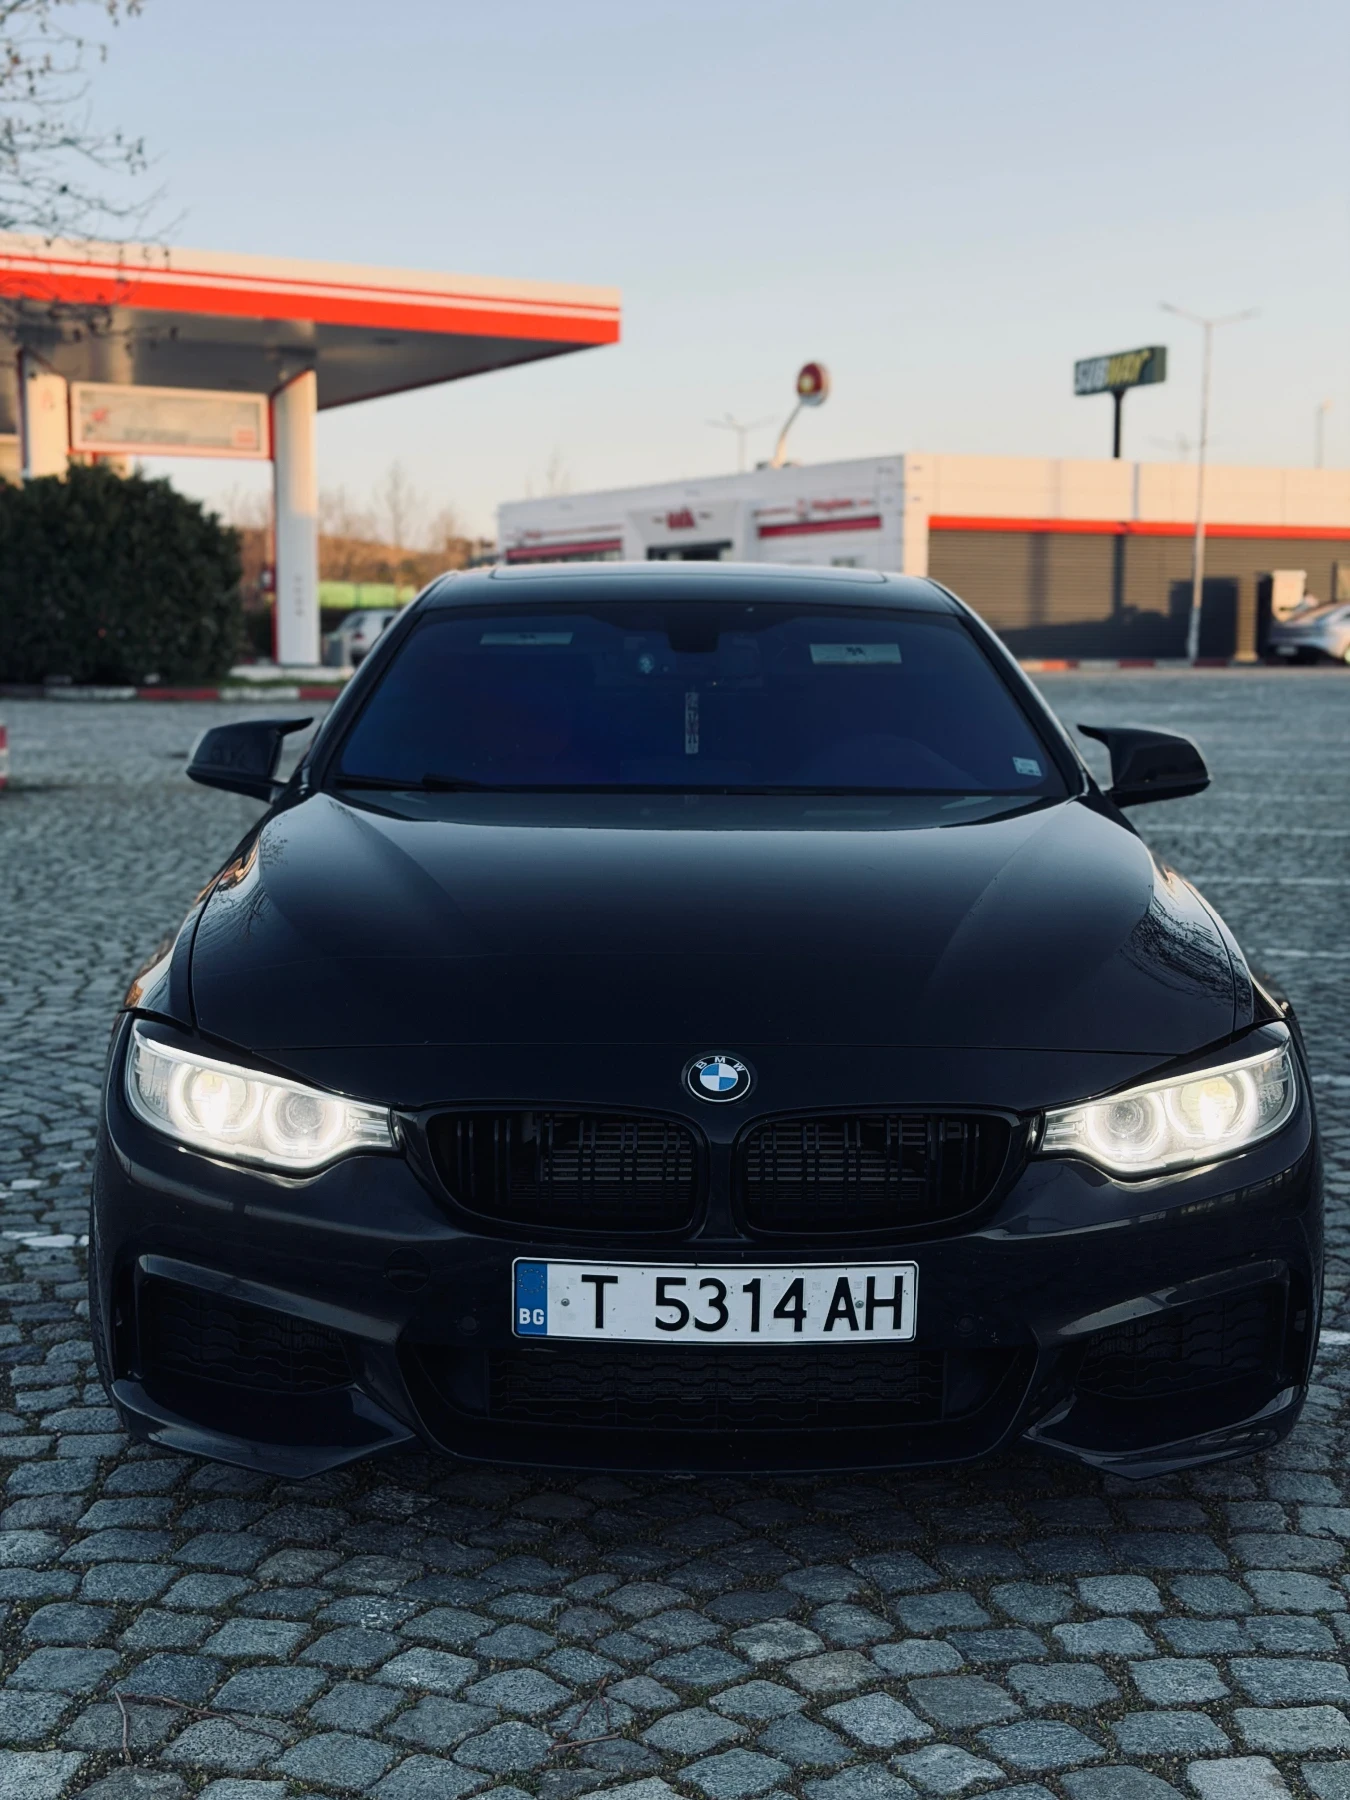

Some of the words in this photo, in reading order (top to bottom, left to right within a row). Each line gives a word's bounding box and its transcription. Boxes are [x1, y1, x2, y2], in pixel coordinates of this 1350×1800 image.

[1076, 350, 1151, 391] SUBWAY
[696, 1057, 746, 1072] BMW
[518, 1307, 546, 1326] BG
[581, 1274, 618, 1329] T
[654, 1277, 807, 1332] 5314
[823, 1275, 904, 1332] AH
